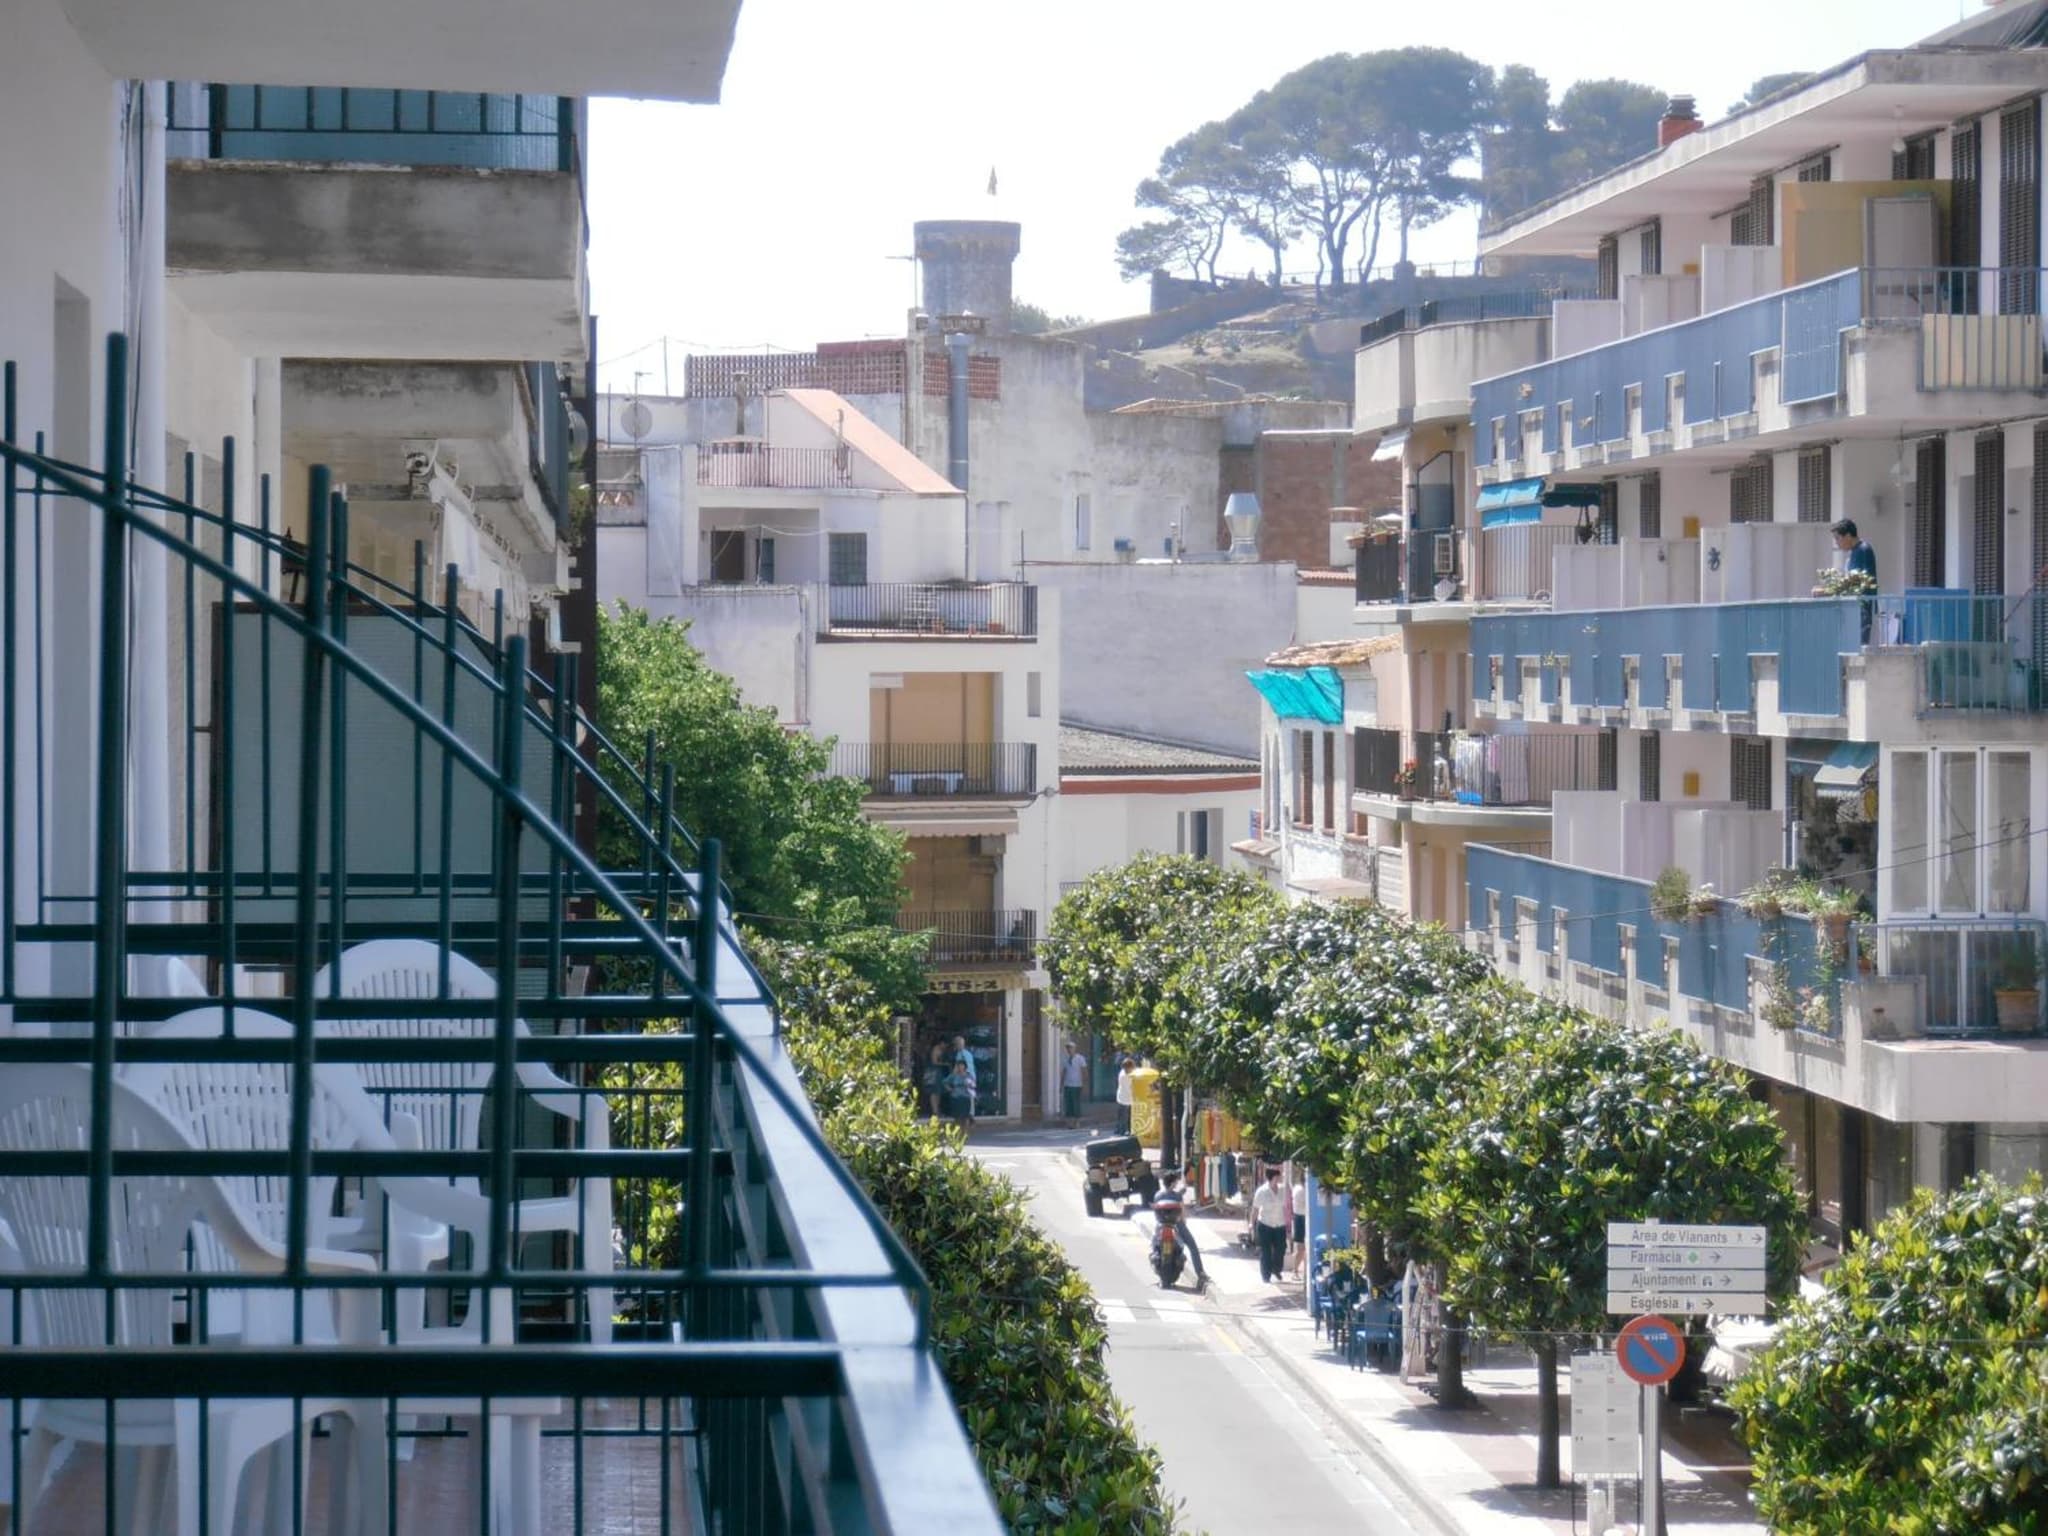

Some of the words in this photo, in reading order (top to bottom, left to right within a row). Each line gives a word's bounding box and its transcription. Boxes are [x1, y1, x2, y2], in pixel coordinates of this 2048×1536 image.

[1662, 1230, 1675, 1242] de
[1678, 1230, 1728, 1243] Vianants
[1631, 1274, 1696, 1288] Ajuntament
[1630, 1296, 1679, 1311] Església
